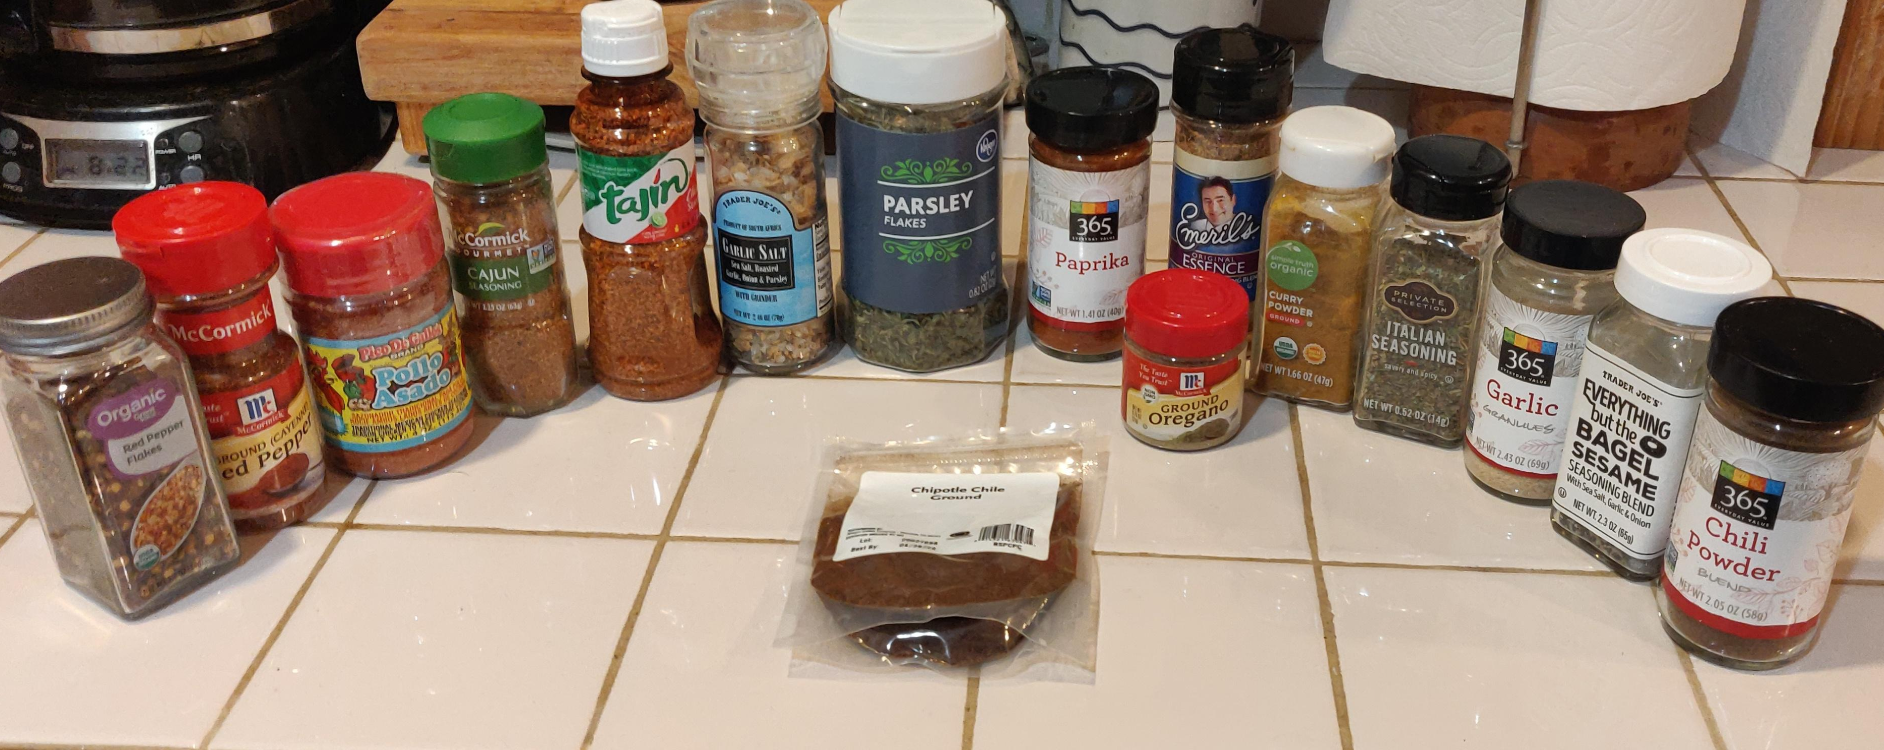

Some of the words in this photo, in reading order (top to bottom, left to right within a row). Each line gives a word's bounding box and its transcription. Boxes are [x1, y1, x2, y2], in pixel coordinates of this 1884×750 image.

[723, 196, 751, 209] TRADER
[753, 197, 778, 214] JOE'S
[883, 190, 974, 215] PARSLEY
[723, 219, 741, 230] PRODUCT
[749, 224, 764, 232] SOUTH
[765, 224, 782, 232] AFRICA
[884, 215, 926, 228] FLAKES
[1076, 215, 1112, 236] 365
[1176, 203, 1260, 250] Emeril's
[722, 236, 755, 259] GARLIC
[759, 244, 787, 261] SALT
[1192, 252, 1235, 263] ORIGINAL
[730, 260, 741, 270] Sea
[754, 264, 779, 273] Roasted
[1055, 251, 1130, 275] Paprika
[1182, 254, 1245, 274] ESSENCE
[1270, 261, 1313, 277] organic
[1271, 254, 1294, 265] simple
[1294, 259, 1314, 268] truth
[468, 266, 520, 284] CAJUN
[469, 280, 522, 292] SEASONING
[742, 273, 758, 283] Onion
[759, 276, 764, 284] &
[766, 274, 788, 284] Parsley
[980, 270, 990, 284] NET
[735, 290, 750, 300] WITH
[751, 294, 778, 302] GRINDER
[968, 286, 980, 298] 0.82
[981, 281, 988, 293] OZ
[1269, 290, 1304, 305] CURRY
[1393, 290, 1445, 307] PRIVATE
[734, 308, 742, 318] NET
[1056, 306, 1068, 316] NET
[1070, 309, 1080, 317] WT
[1082, 310, 1095, 318] 1.41
[1096, 309, 1106, 318] OZ
[1107, 306, 1124, 317] (40g)
[1268, 301, 1314, 318] POWDER
[1391, 297, 1447, 313] SELECTION
[168, 304, 272, 342] McCormick
[1269, 313, 1300, 325] GROUND
[1386, 320, 1446, 346] ITALIAN
[358, 344, 391, 362] Pico
[390, 344, 424, 360] BRAND
[1278, 340, 1294, 349] USDA
[1371, 334, 1457, 366] SEASONING
[372, 351, 443, 388] Pollo
[1140, 363, 1150, 373] The
[1152, 368, 1168, 378] Taste
[1384, 363, 1404, 373] savory
[1406, 368, 1419, 376] and
[1505, 349, 1545, 377] 365
[1138, 371, 1150, 381] You
[1151, 376, 1168, 386] Trust
[1261, 362, 1273, 373] NET
[1274, 365, 1286, 376] WT
[1287, 368, 1302, 380] 1.66
[1303, 372, 1312, 382] OZ
[1314, 374, 1334, 388] (47g)
[1500, 366, 1527, 381] EVERYDAY
[1528, 377, 1547, 385] VALUE
[372, 368, 451, 410] Asado
[1144, 387, 1156, 395] NON
[1144, 392, 1156, 400] GMO
[1174, 388, 1207, 396] McCormick
[1487, 378, 1559, 416] Garlic
[1602, 370, 1634, 394] TRADER
[1636, 389, 1660, 408] JOE'S
[97, 388, 167, 427] Organic
[1149, 399, 1229, 428] Oregano
[1161, 394, 1219, 413] GROUND
[1363, 398, 1378, 410] NET
[1380, 401, 1393, 413] WT
[1394, 406, 1412, 418] 0.52
[1414, 411, 1427, 421] OZ
[1427, 413, 1450, 428] (14g)
[1583, 377, 1671, 440] EVERYTHING
[237, 410, 285, 434] McCormick
[1482, 404, 1556, 434] GRANULES
[1590, 404, 1614, 432] but
[1616, 420, 1637, 444] the
[122, 437, 145, 454] Red
[146, 420, 184, 444] Pepper
[222, 462, 249, 480] ed
[258, 412, 312, 470] Pepper
[367, 436, 384, 444] NET
[126, 444, 163, 466] Flakes
[217, 440, 266, 465] GROUND
[1476, 436, 1486, 449] NET
[1486, 444, 1496, 456] WT
[1496, 449, 1514, 463] 2.43
[1515, 455, 1526, 466] OZ
[1527, 458, 1550, 470] (69g)
[1576, 417, 1660, 482] BAGEL
[1572, 441, 1658, 502] SESAME
[911, 486, 968, 495] Chipotle
[1568, 458, 1621, 500] SEASONING
[1621, 491, 1655, 517] BLEND
[1566, 473, 1582, 489] With
[1582, 482, 1593, 495] Sea
[1593, 490, 1607, 506] Salt,
[1607, 498, 1624, 516] Garlic
[1624, 510, 1630, 519] &
[1630, 513, 1651, 529] Onion
[1720, 485, 1769, 518] 365
[1573, 498, 1586, 512] NET
[1586, 505, 1597, 521] WT.
[1597, 514, 1608, 527] 2.3
[1608, 522, 1618, 534] OZ
[1714, 503, 1745, 521] EVERYDAY
[1747, 518, 1770, 528] VALUE
[1705, 516, 1768, 554] Chili
[1687, 529, 1781, 582] Powder
[1697, 567, 1752, 593] BLEND
[1679, 577, 1690, 592] NET
[1691, 586, 1705, 602] WT
[1705, 595, 1724, 611] 2.05
[1727, 604, 1740, 616] OZ
[1741, 608, 1768, 622] (58g)
